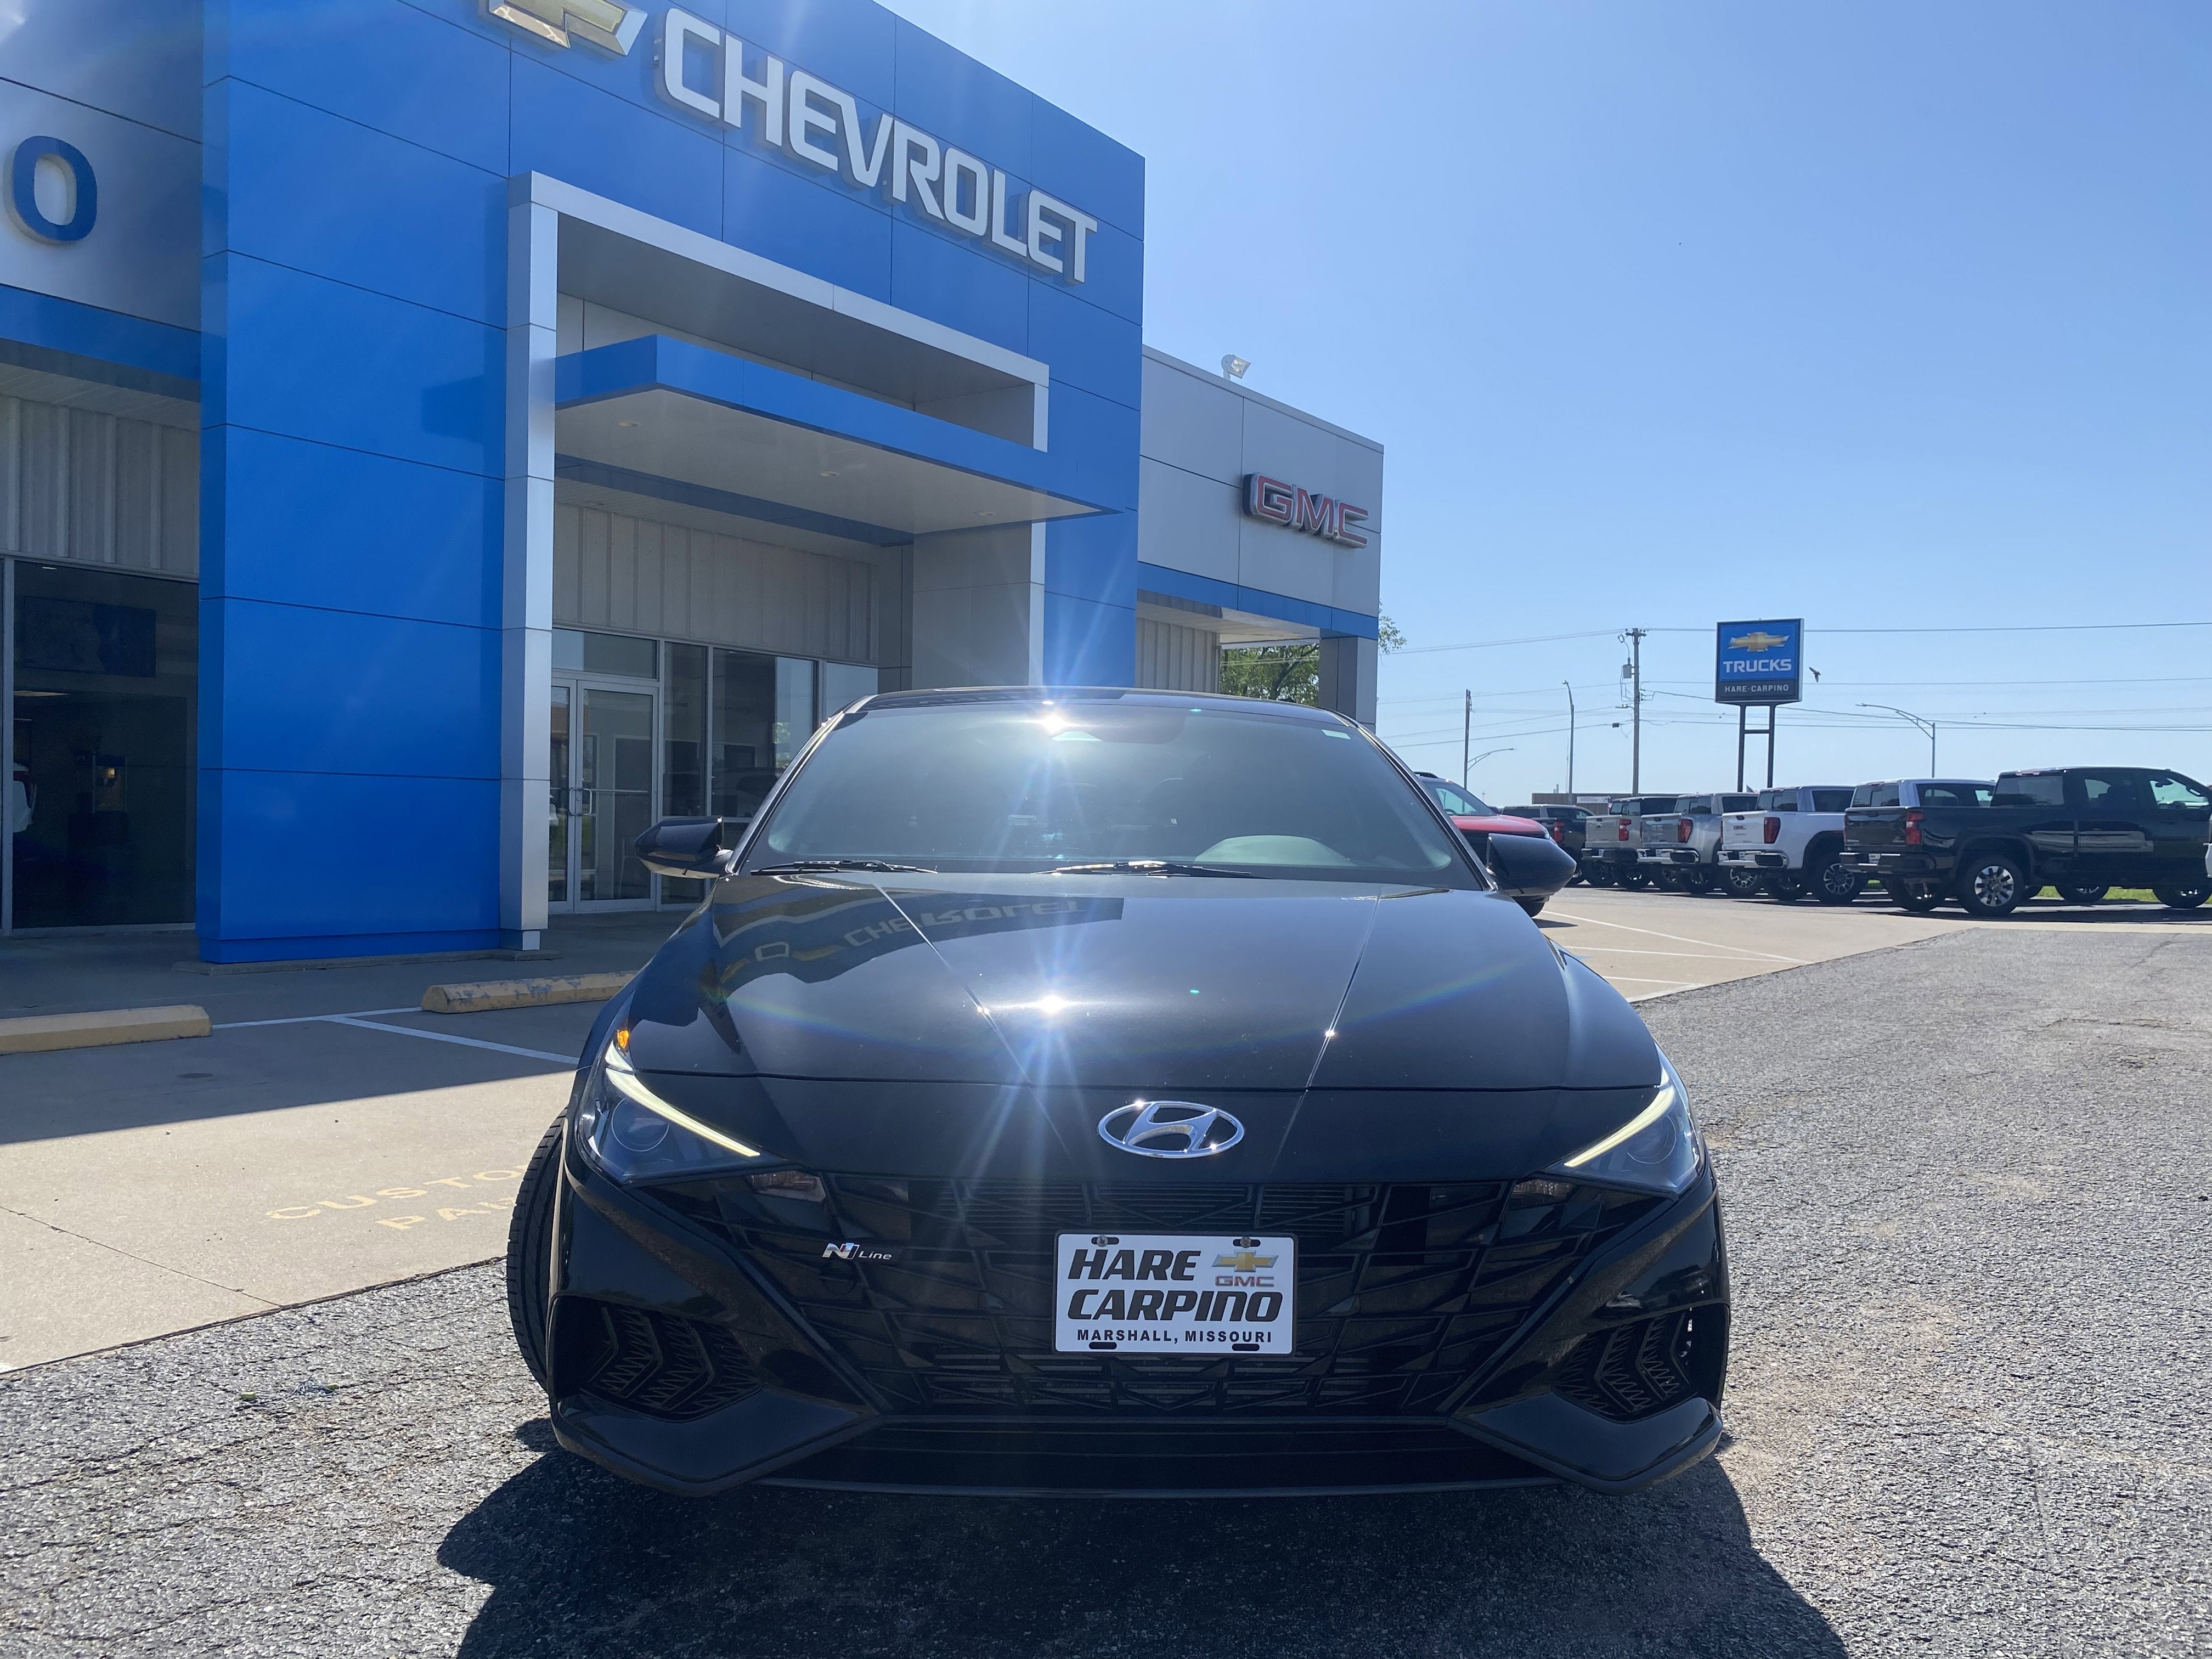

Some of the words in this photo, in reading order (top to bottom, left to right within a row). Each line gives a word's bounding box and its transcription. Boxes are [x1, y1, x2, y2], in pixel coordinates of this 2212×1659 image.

[664, 8, 1097, 284] CHEVROLET
[11, 134, 98, 241] O
[1253, 473, 1369, 549] GMC
[1723, 658, 1792, 673] TRUCKS
[1724, 685, 1789, 693] HARE-CARPINO
[266, 1164, 528, 1220] CUSTO
[858, 1250, 892, 1260] Line
[1067, 1249, 1201, 1281] HARE
[1215, 1275, 1275, 1287] GMC
[1067, 1289, 1283, 1322] CARPINO
[1077, 1329, 1179, 1344] MARSHALL,
[1185, 1330, 1272, 1343] MISSOURI
